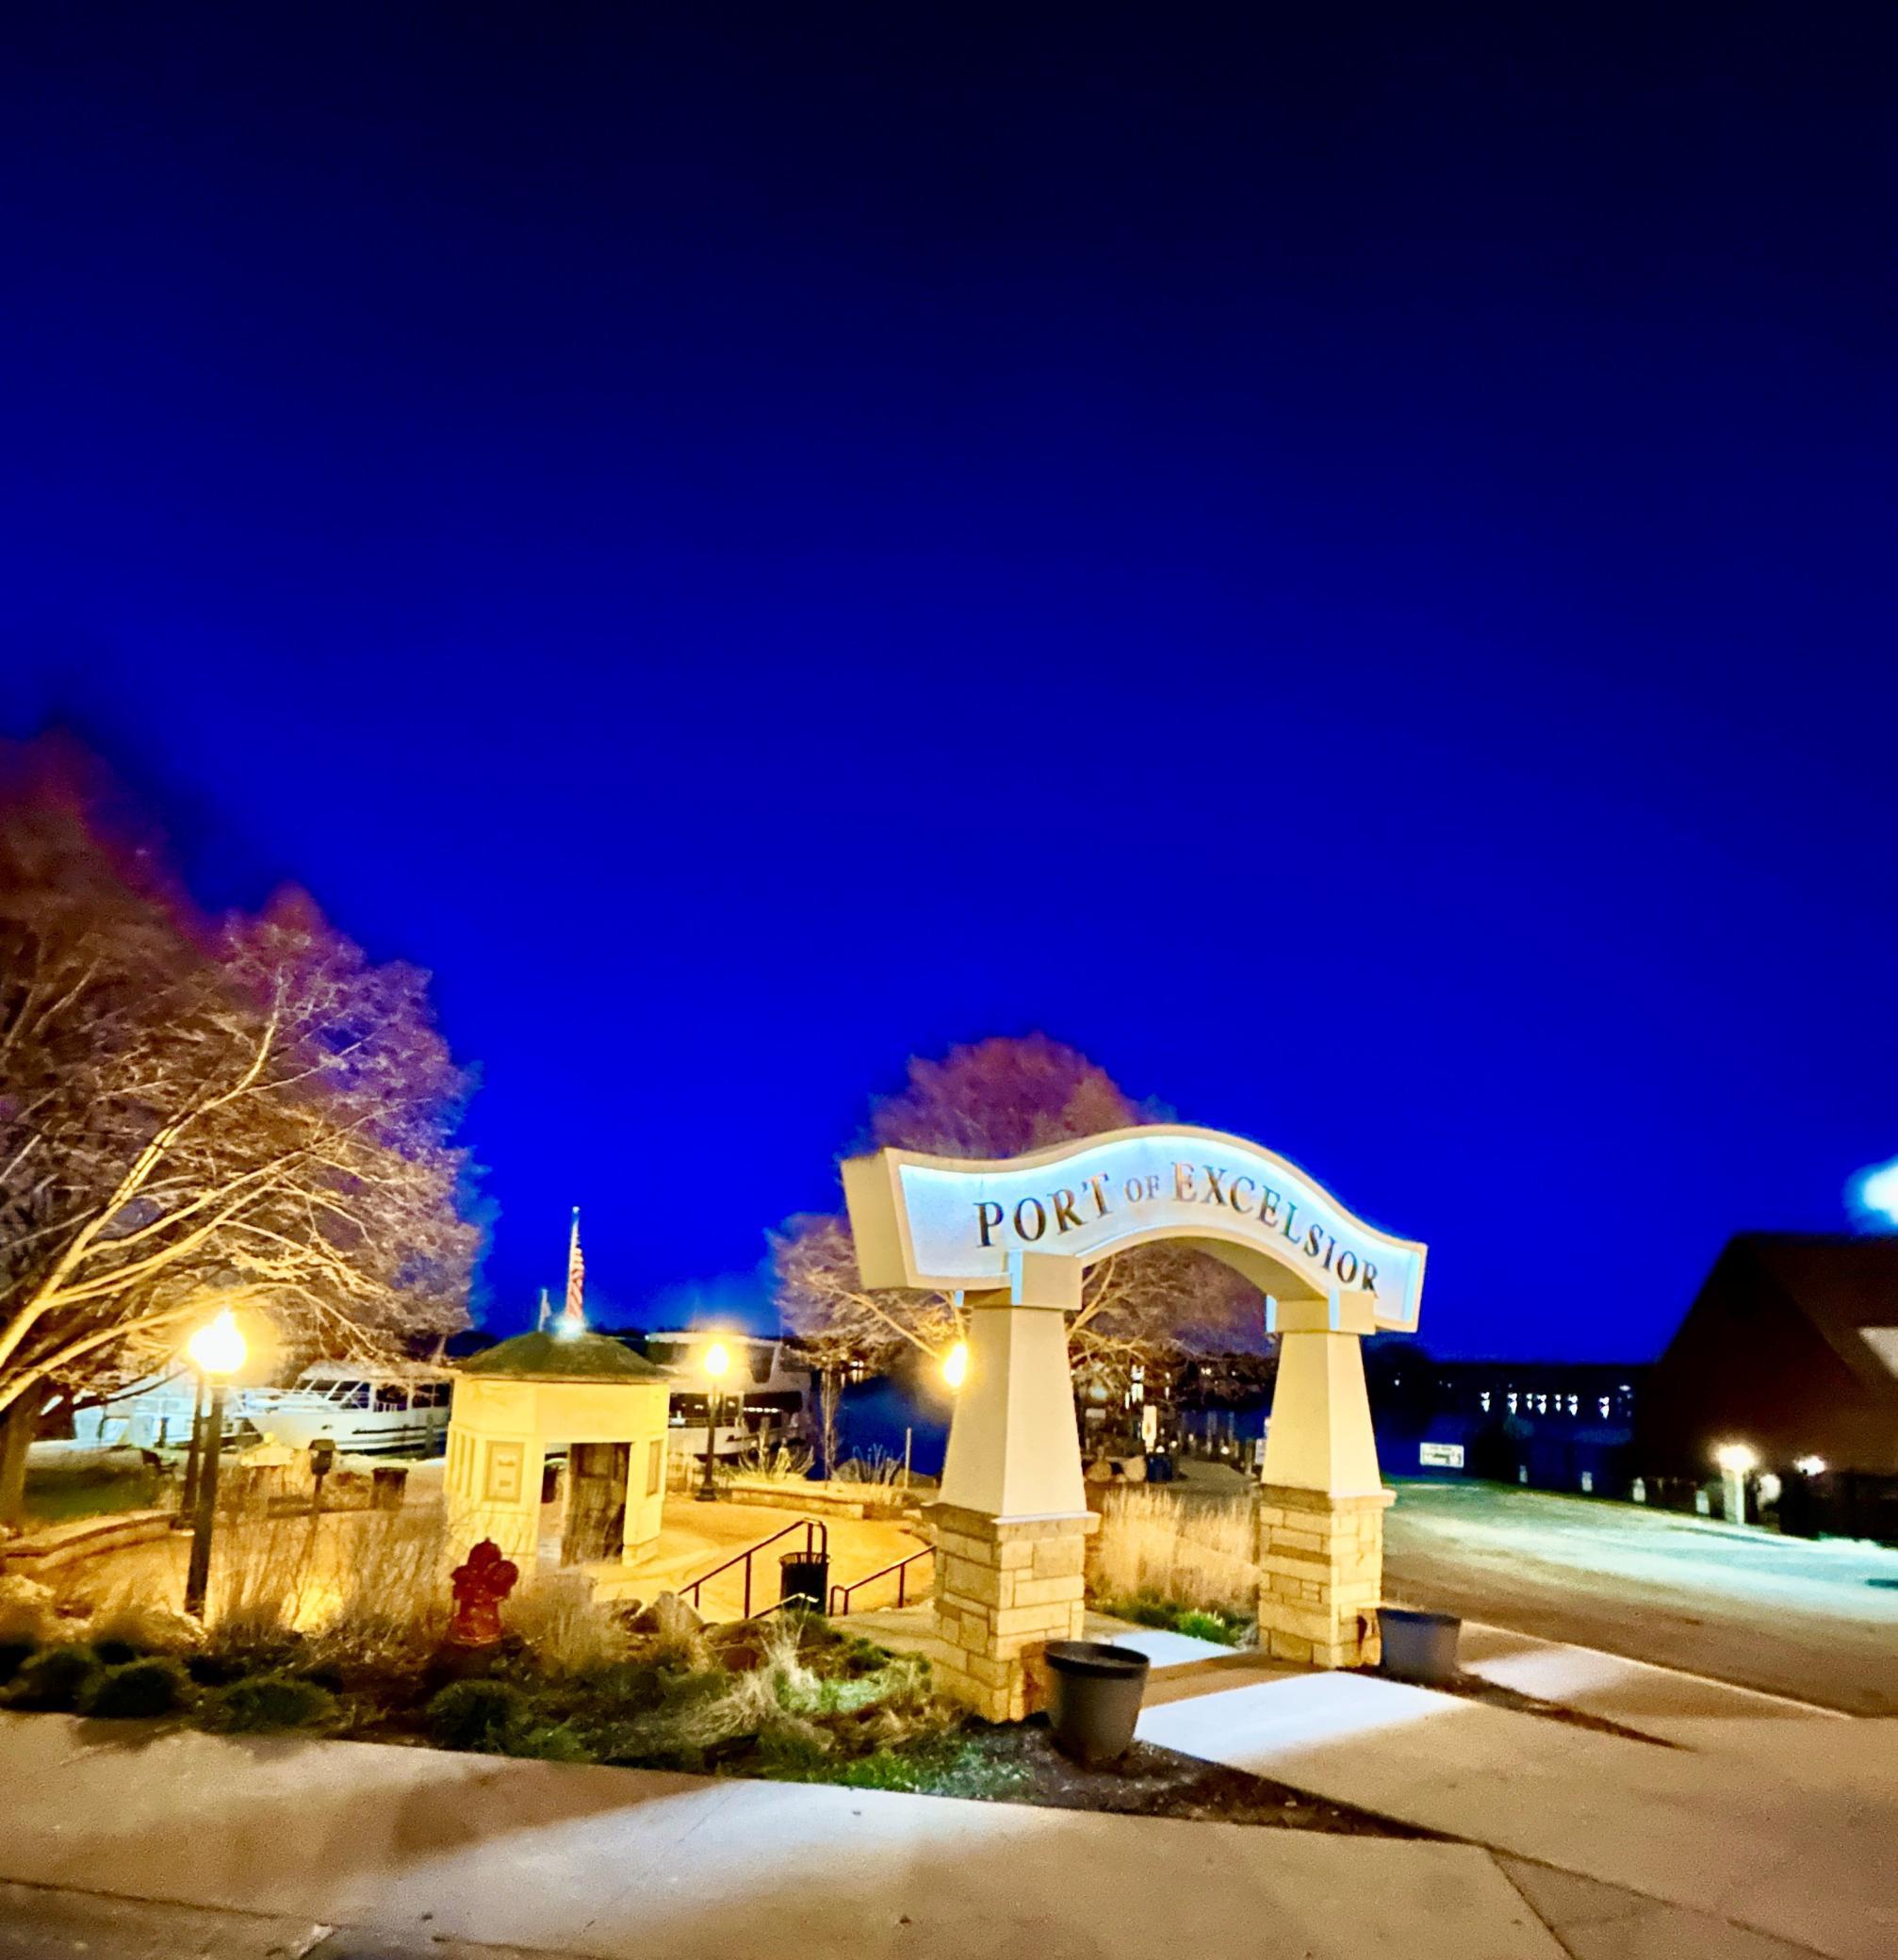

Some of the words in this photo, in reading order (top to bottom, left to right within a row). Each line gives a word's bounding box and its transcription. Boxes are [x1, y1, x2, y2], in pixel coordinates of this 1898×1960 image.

[974, 1171, 1112, 1249] PORT
[1124, 1175, 1160, 1202] OF
[1170, 1161, 1379, 1297] EXCELSIOR
